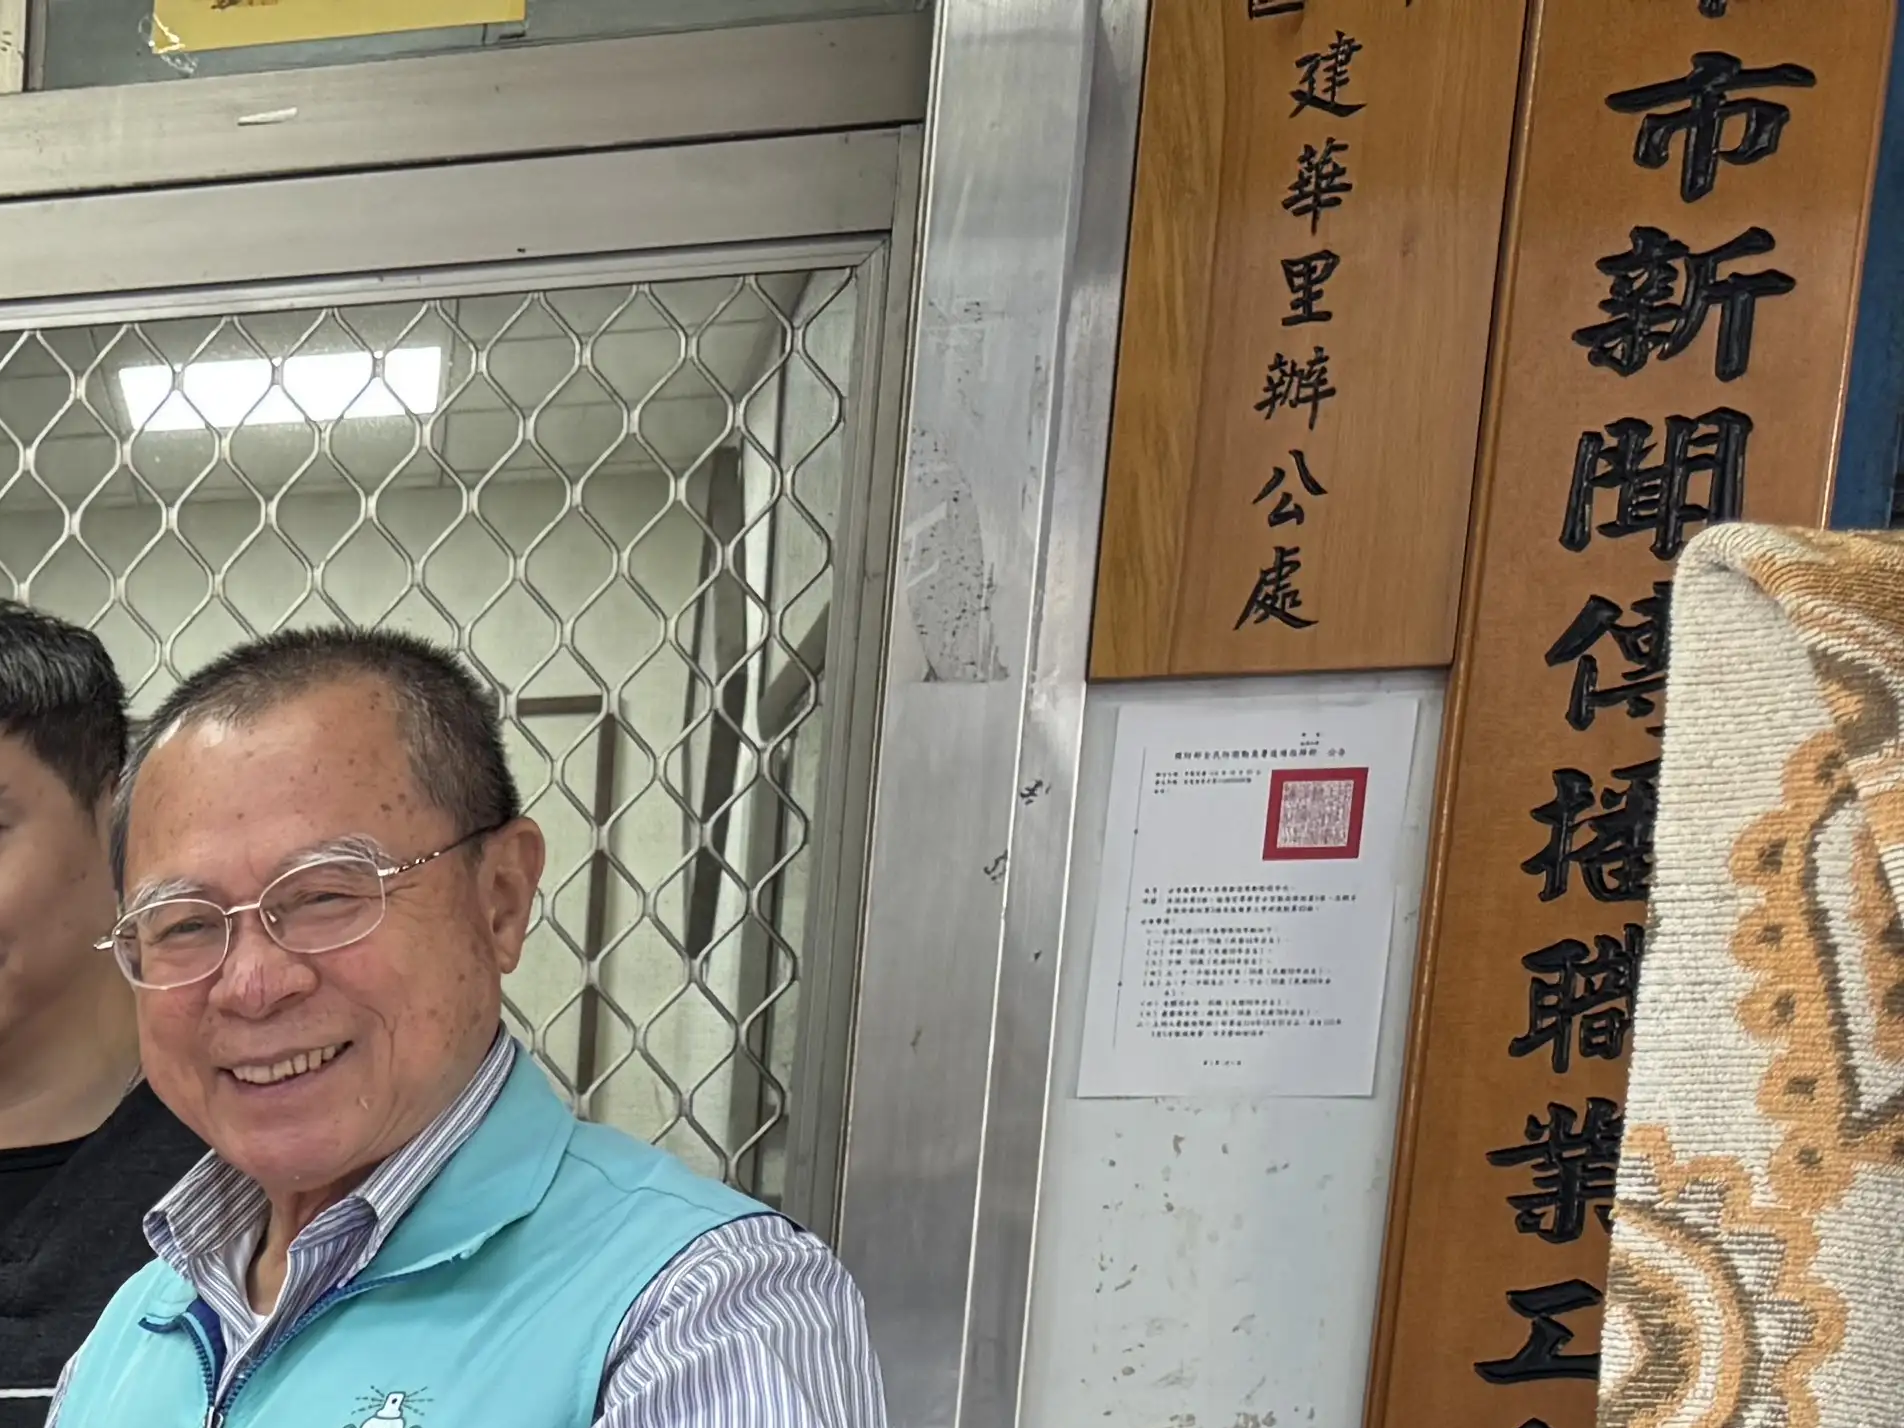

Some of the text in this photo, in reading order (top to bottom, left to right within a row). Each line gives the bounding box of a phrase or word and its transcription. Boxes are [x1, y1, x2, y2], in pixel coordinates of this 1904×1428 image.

[1235, 30, 1368, 632] 建華里辦公處
